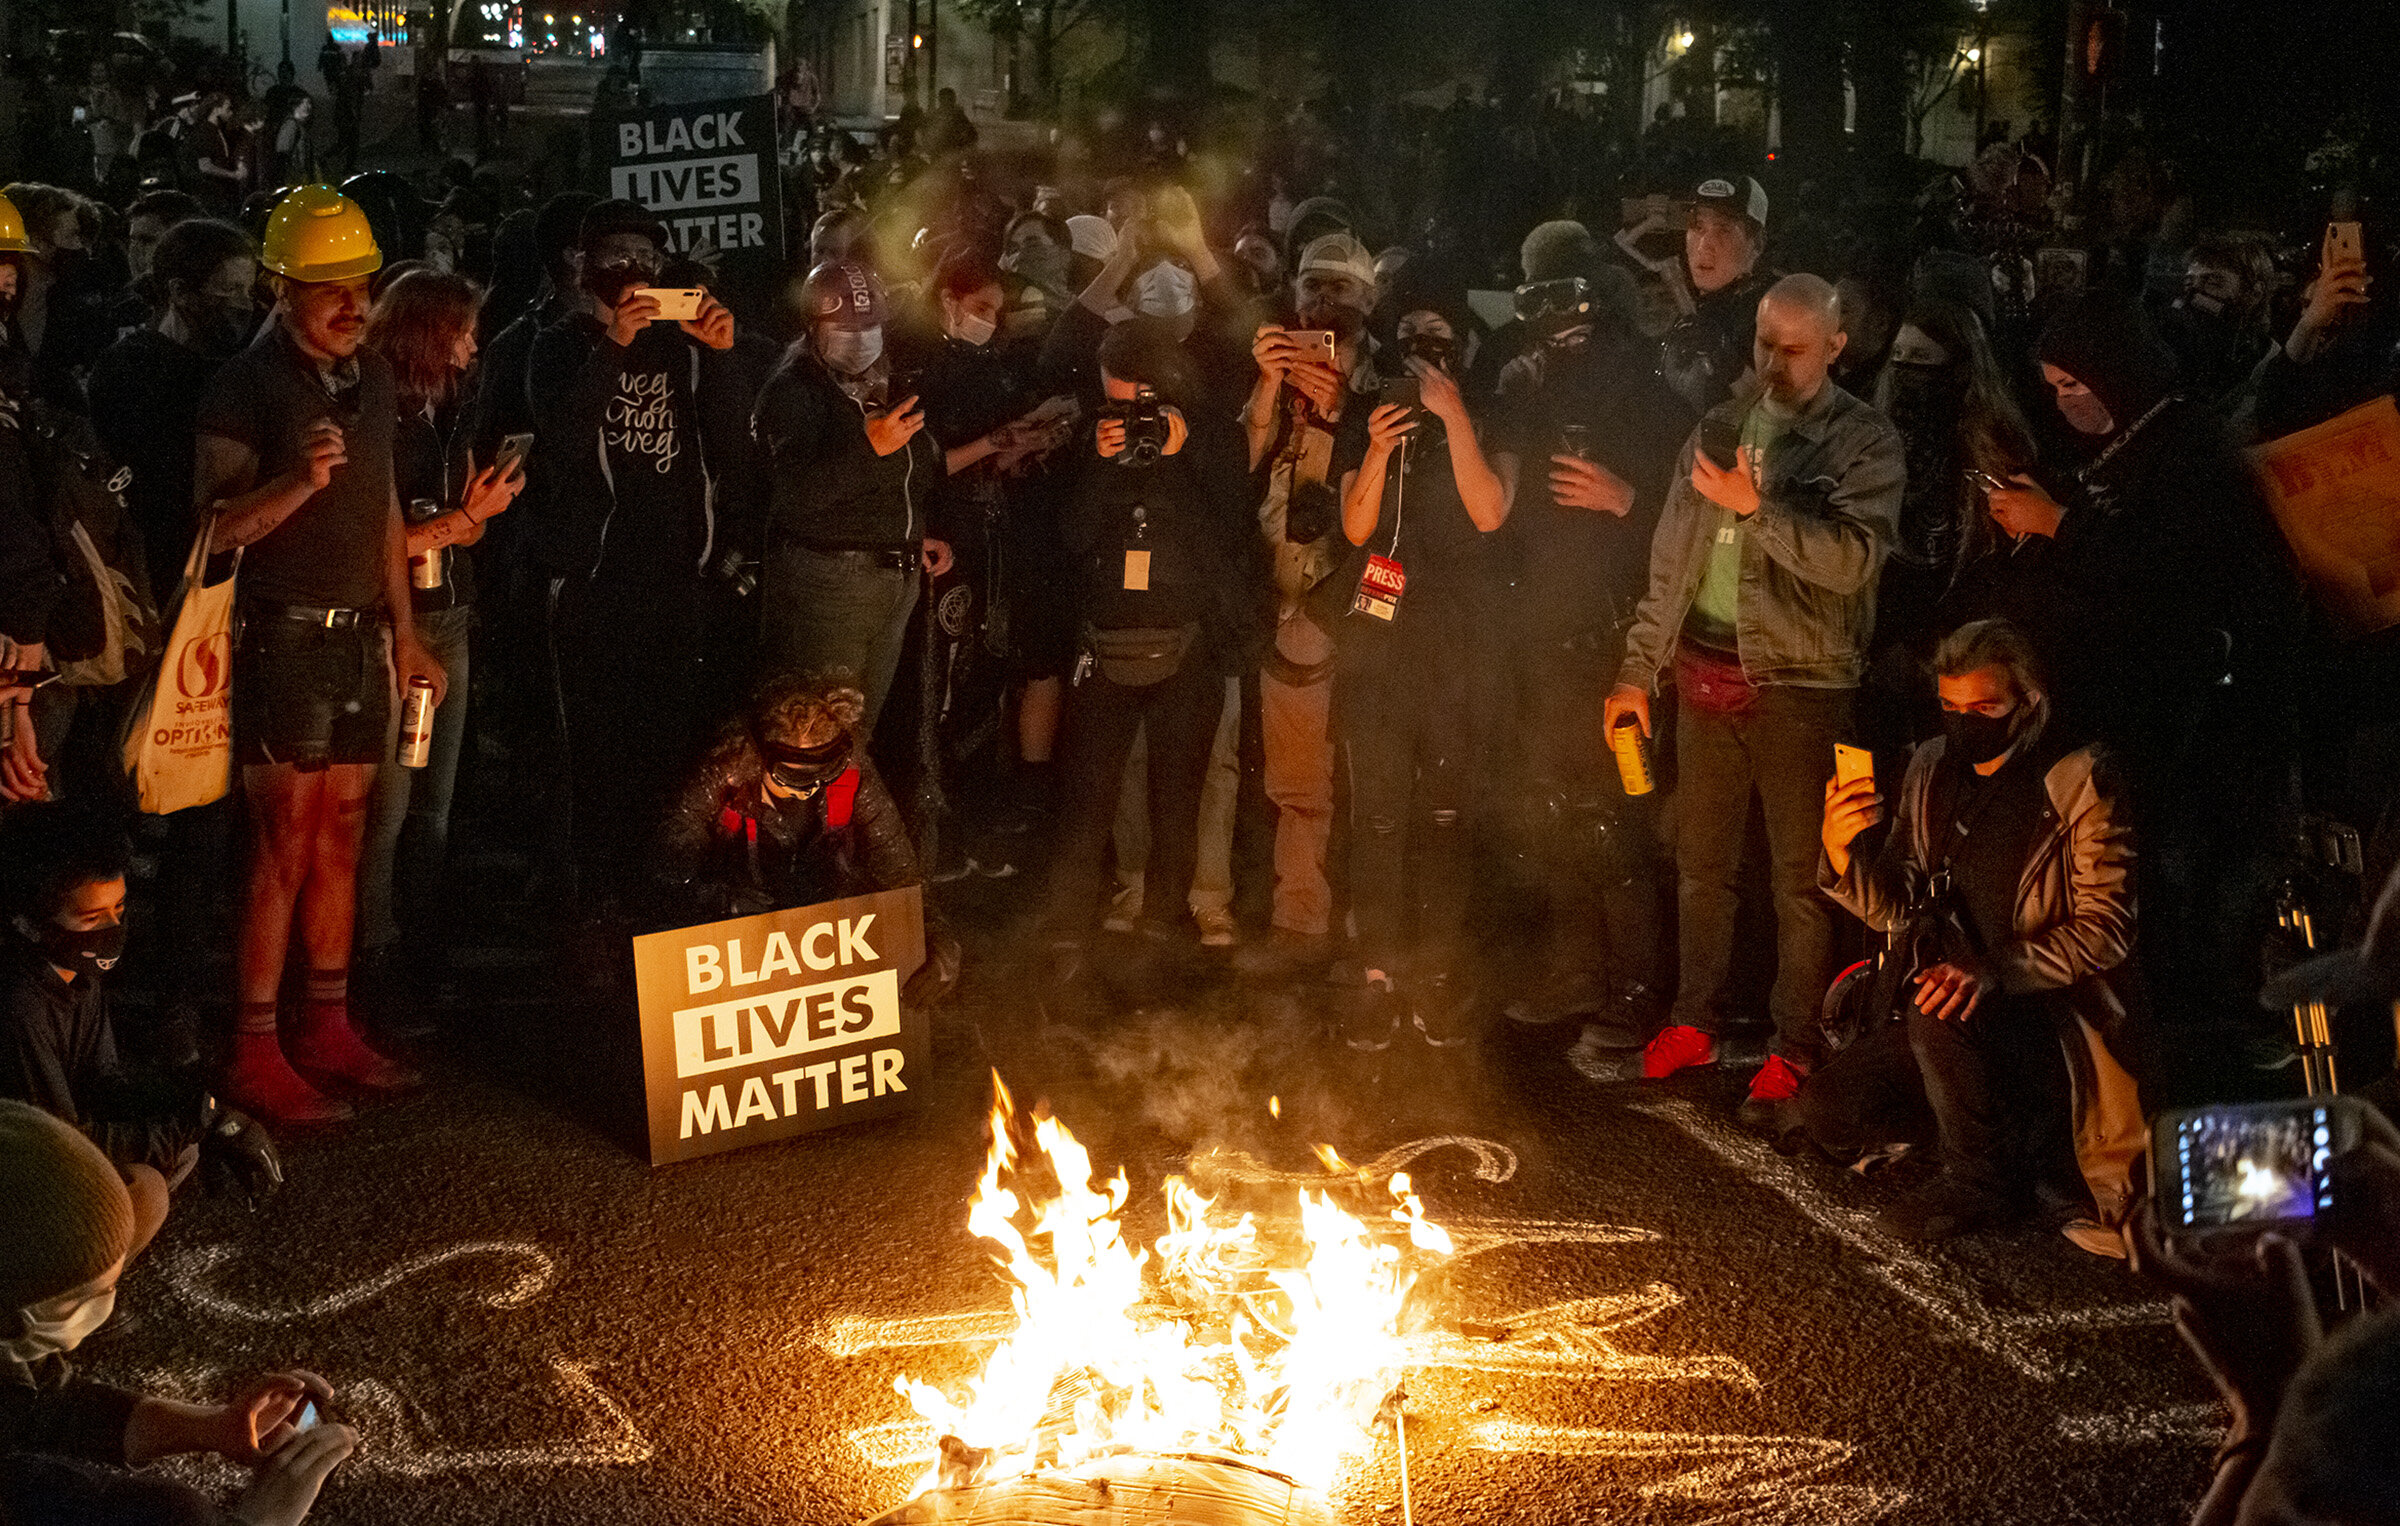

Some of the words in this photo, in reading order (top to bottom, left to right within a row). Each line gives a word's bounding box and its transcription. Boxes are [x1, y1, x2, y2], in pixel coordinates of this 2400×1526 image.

[619, 111, 745, 157] BLACK
[628, 162, 742, 205] LIVES
[658, 212, 765, 254] TTER
[605, 396, 678, 430] non
[618, 372, 674, 414] veg
[607, 430, 680, 473] veg
[1364, 563, 1405, 590] PRESS
[176, 696, 231, 714] SAFEWAY
[686, 914, 880, 995] BLACK
[700, 985, 874, 1063] LIVES
[680, 1048, 908, 1140] MATTER
